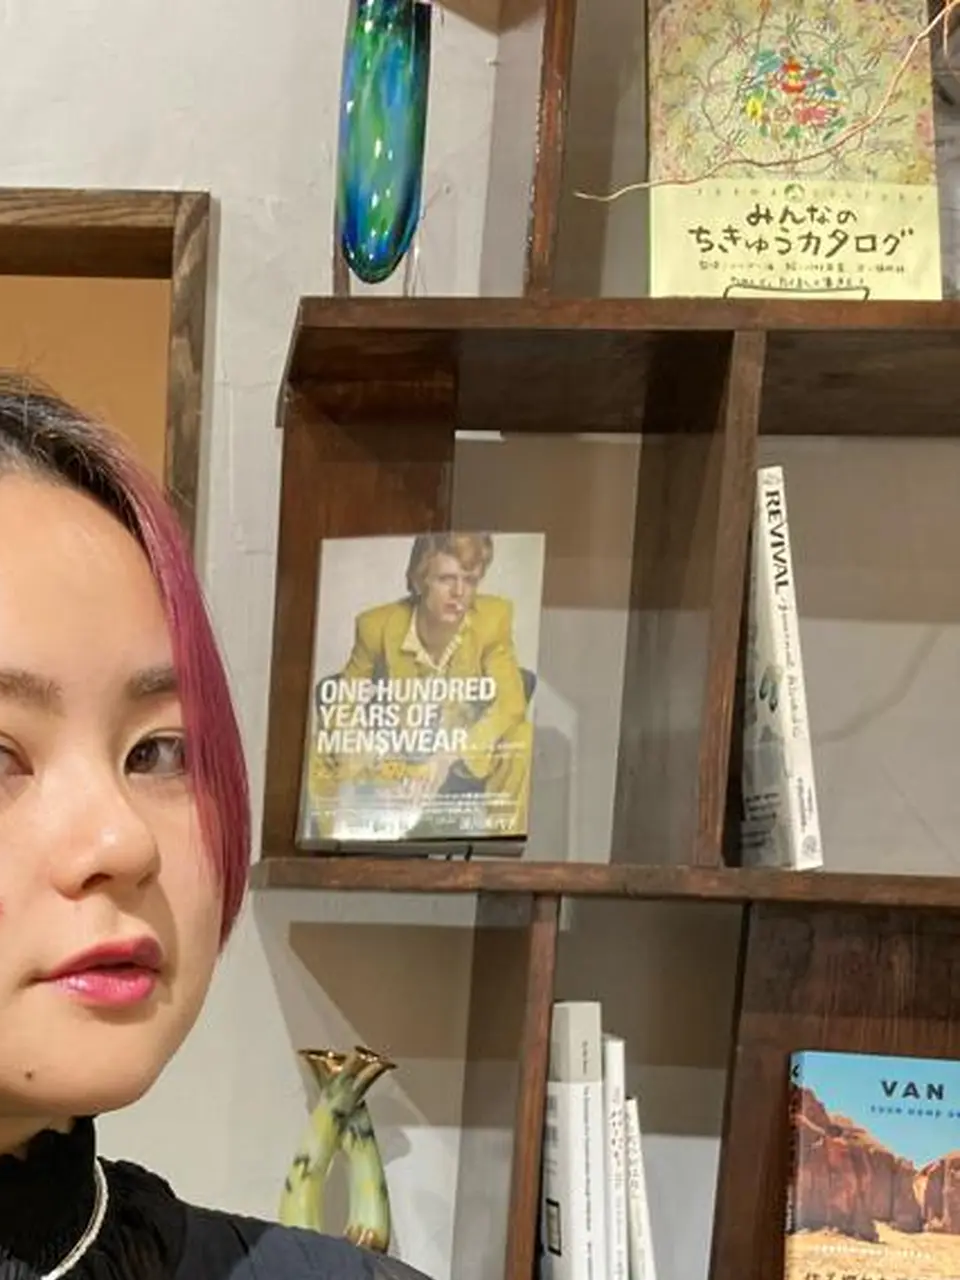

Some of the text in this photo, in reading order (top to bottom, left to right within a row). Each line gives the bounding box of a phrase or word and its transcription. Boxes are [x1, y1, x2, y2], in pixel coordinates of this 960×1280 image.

[746, 203, 858, 225] みんなの
[688, 225, 915, 258] ちきゅうカタログ
[764, 490, 790, 594] REVIVAL
[321, 677, 497, 704] ONE HUNDRED
[320, 703, 439, 728] YEARS OF
[317, 730, 469, 754] MENSWEAR
[881, 1080, 945, 1101] VAN
